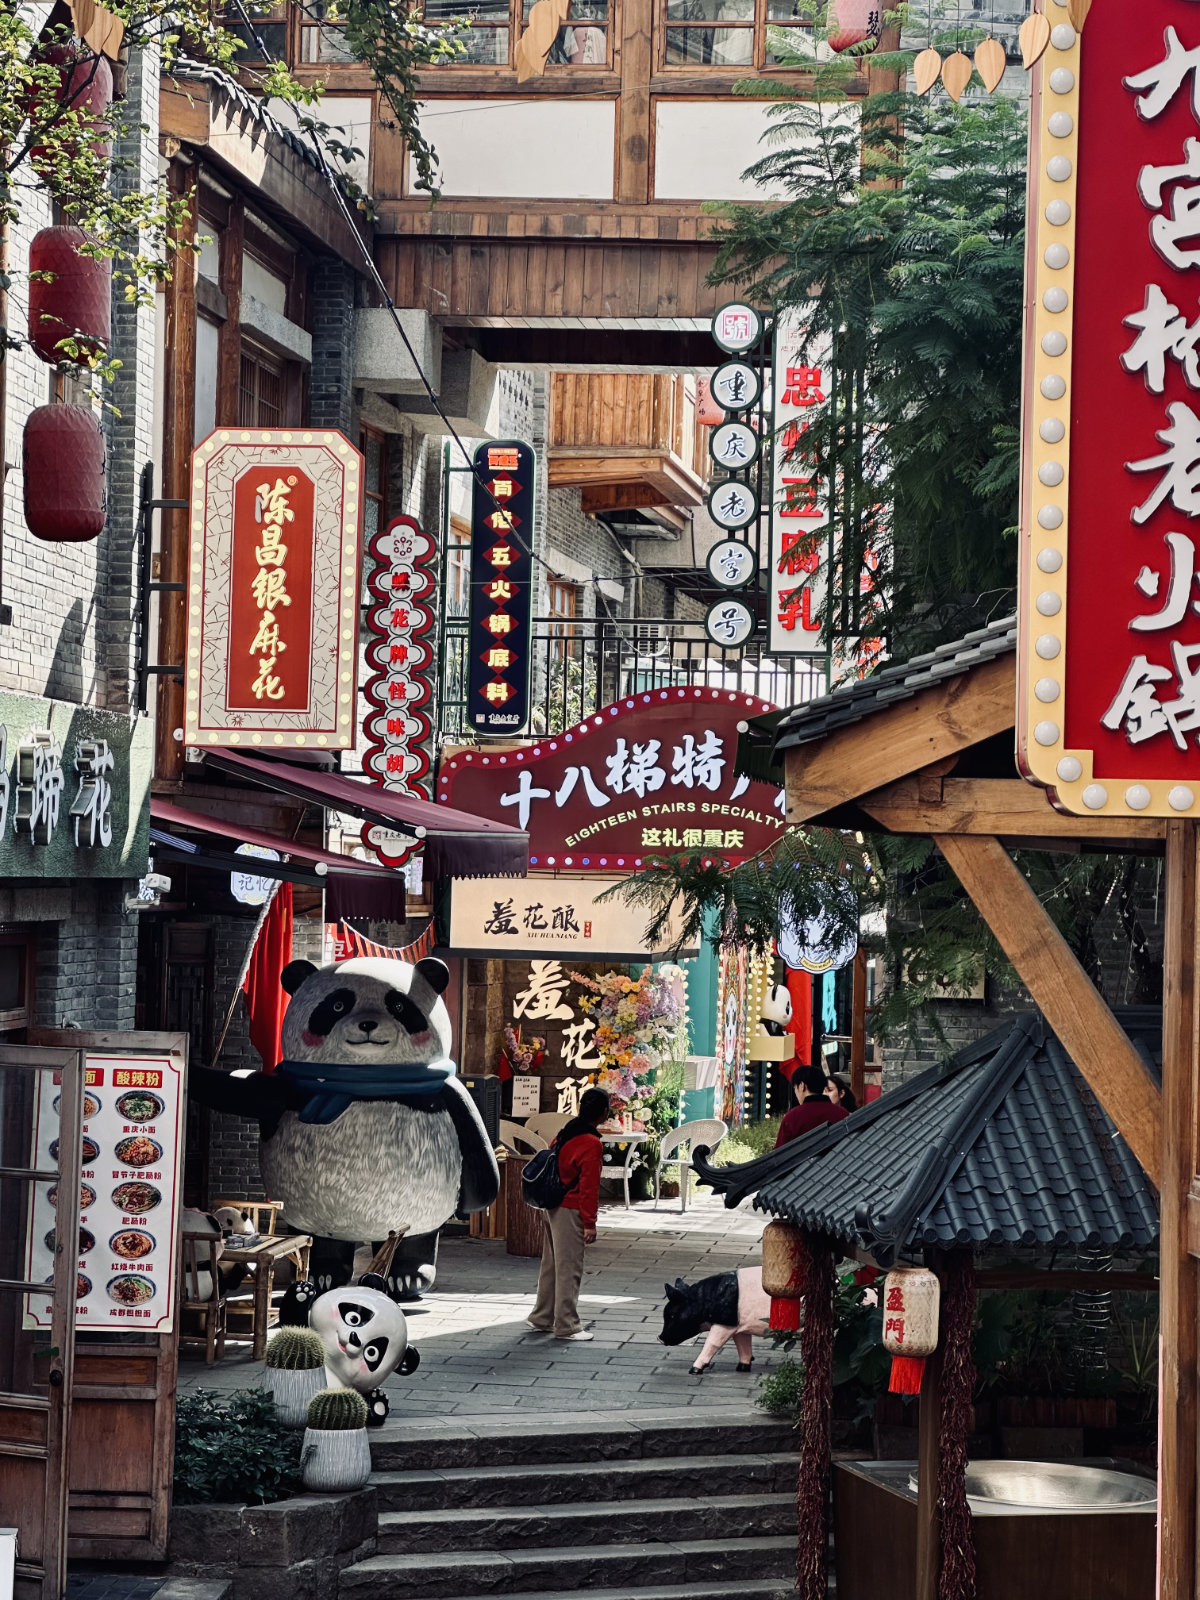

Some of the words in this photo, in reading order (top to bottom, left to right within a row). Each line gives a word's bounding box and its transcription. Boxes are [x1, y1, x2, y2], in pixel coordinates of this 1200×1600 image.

[714, 370, 747, 640] 重庆老字号
[250, 478, 295, 700] 陈昌银麻花
[386, 571, 411, 776] 蝶花牌怪味胡
[0, 722, 114, 848] 蹄花
[500, 729, 785, 831] 十八梯特
[564, 809, 638, 848] EIGHTEEN
[641, 802, 696, 817] STAIRS
[701, 802, 784, 829] SPECIALTY
[641, 827, 745, 849] 这礼很重庆
[484, 897, 580, 936] 羞花酿
[116, 1070, 160, 1086] 酸辣粉
[123, 1126, 156, 1134] 重庆小面
[122, 1217, 147, 1226] 肥肠粉
[111, 1263, 153, 1272] 红烧牛肉面
[109, 1309, 151, 1318] 成都担担面
